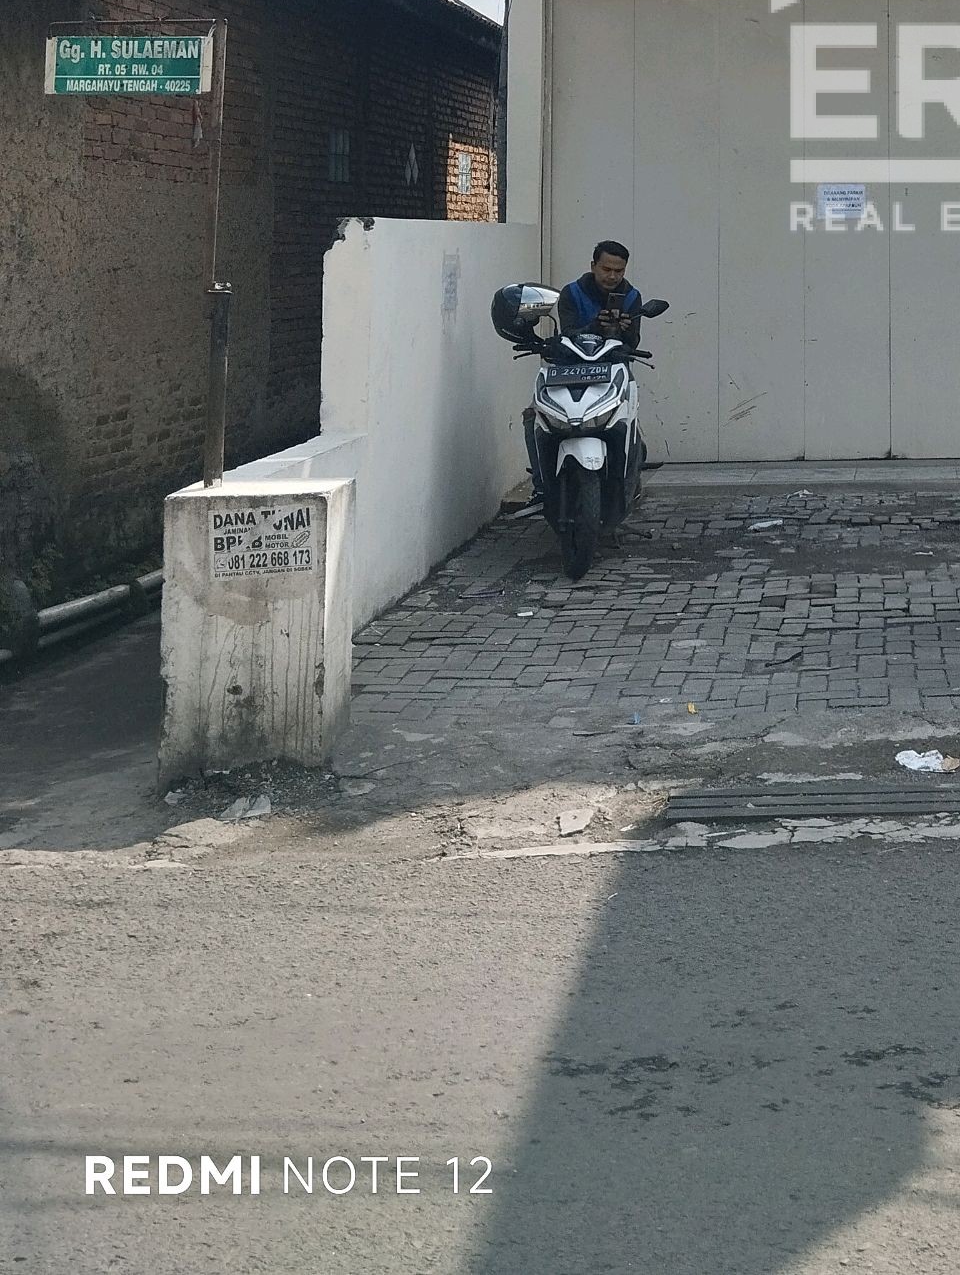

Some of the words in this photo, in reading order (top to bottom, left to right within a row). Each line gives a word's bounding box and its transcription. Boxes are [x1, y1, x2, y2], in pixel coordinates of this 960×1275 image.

[59, 39, 85, 63] Gg.
[90, 40, 106, 58] H.
[111, 39, 199, 59] SULAEMAN
[98, 64, 112, 75] RT.
[114, 64, 126, 75] 05
[131, 64, 149, 75] RW.
[151, 64, 163, 75] 04
[66, 80, 121, 92] MARGAHAYU
[123, 79, 157, 92] TENGAH
[164, 79, 190, 92] 40225
[213, 511, 256, 530] DANA
[264, 533, 288, 541] MOBIL
[264, 541, 289, 549] MOTOR
[228, 554, 246, 570] 081
[249, 552, 268, 568] 222
[270, 551, 289, 566] 668
[293, 549, 311, 565] 173
